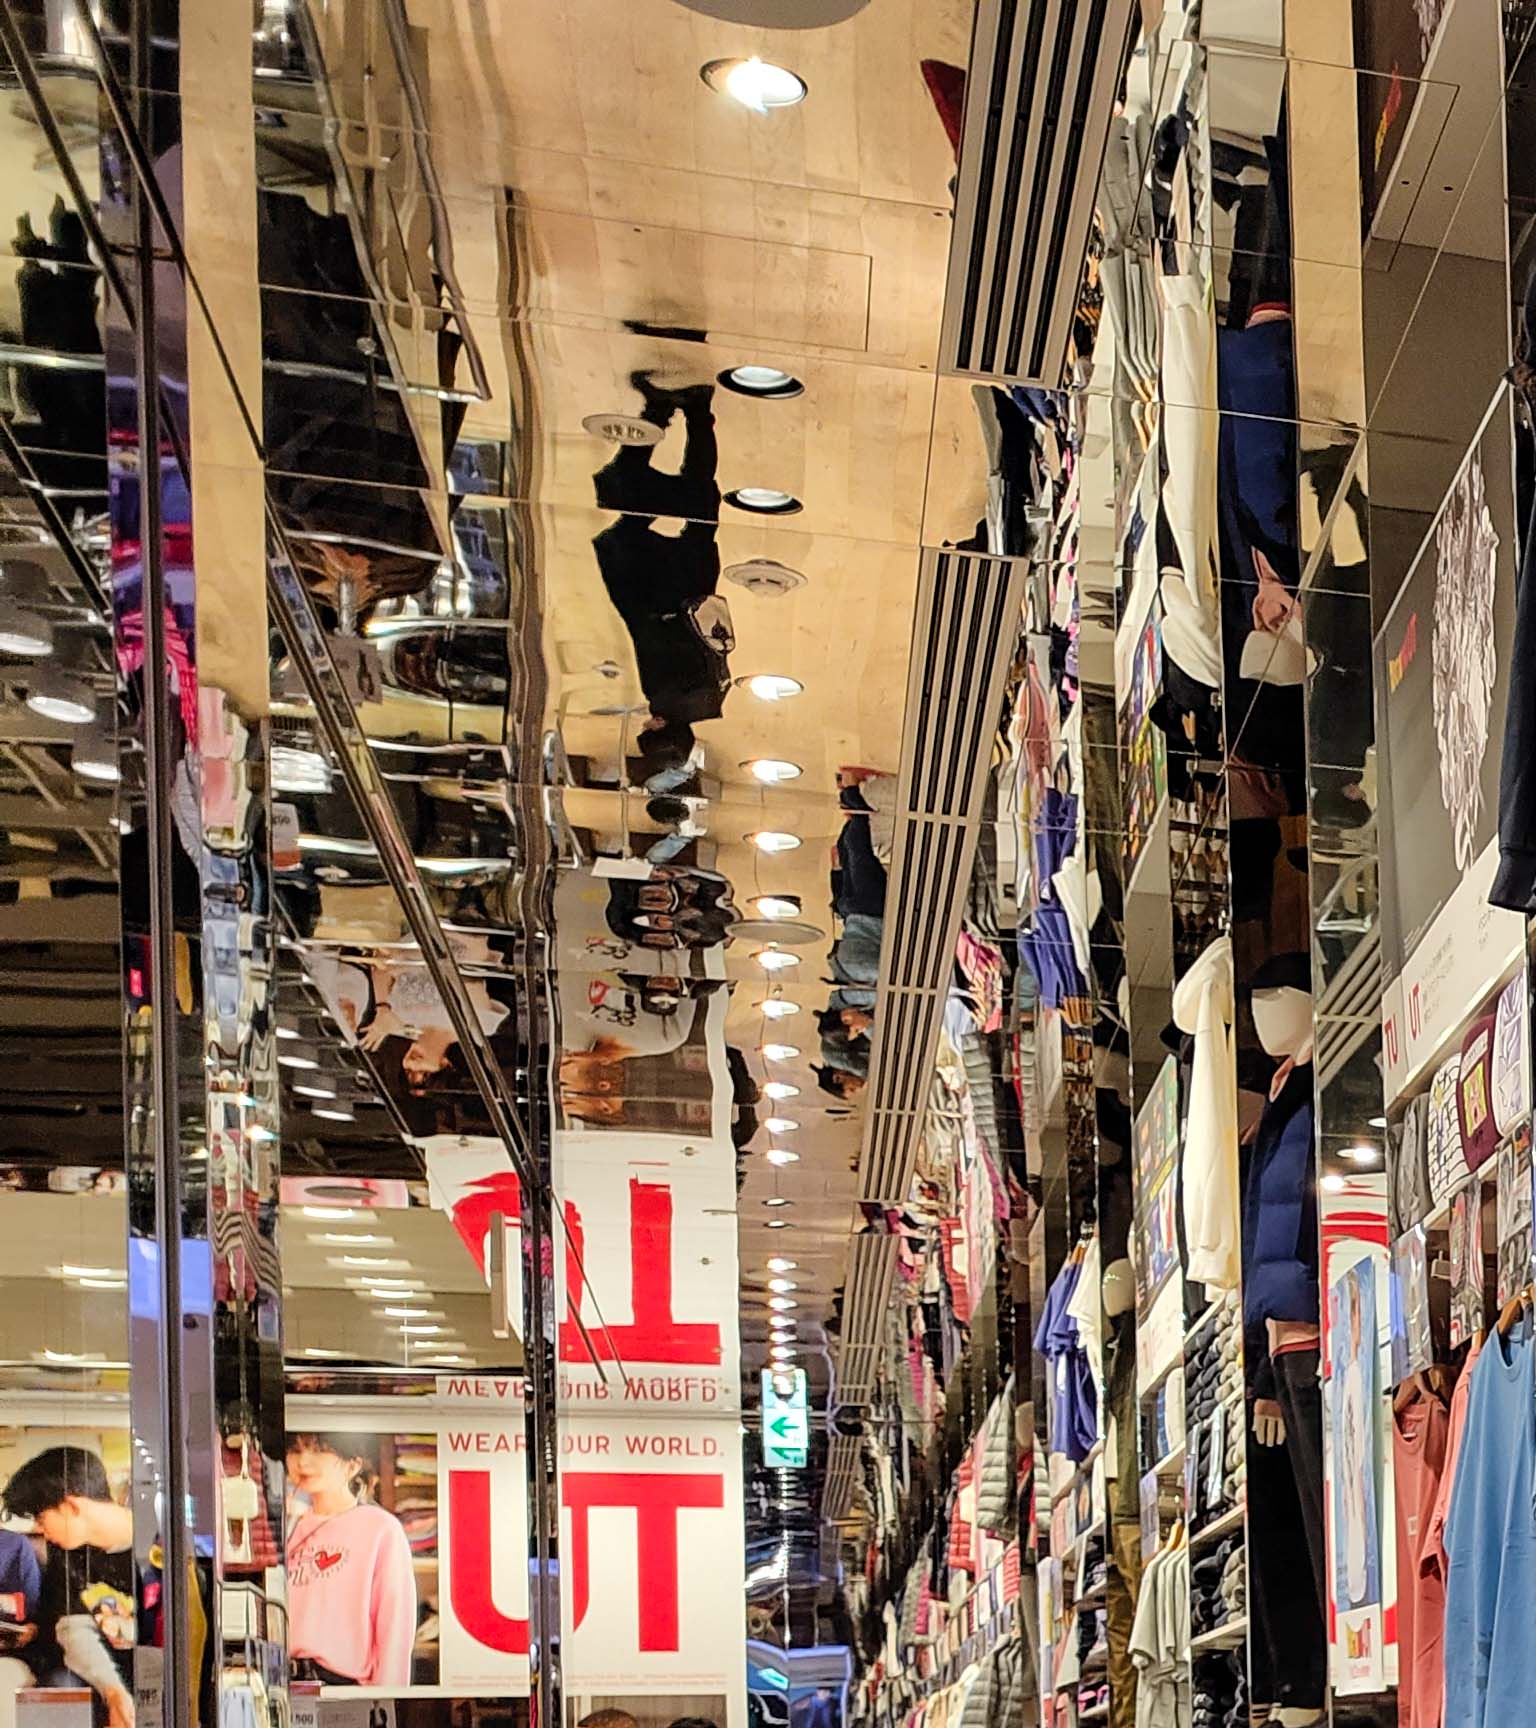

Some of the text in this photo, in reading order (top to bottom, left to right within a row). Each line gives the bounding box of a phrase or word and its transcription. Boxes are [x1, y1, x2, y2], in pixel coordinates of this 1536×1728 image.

[1408, 982, 1421, 1040] UT
[448, 1432, 527, 1453] WEAR
[625, 1435, 725, 1457] WORLD.
[449, 1470, 724, 1655] UT
